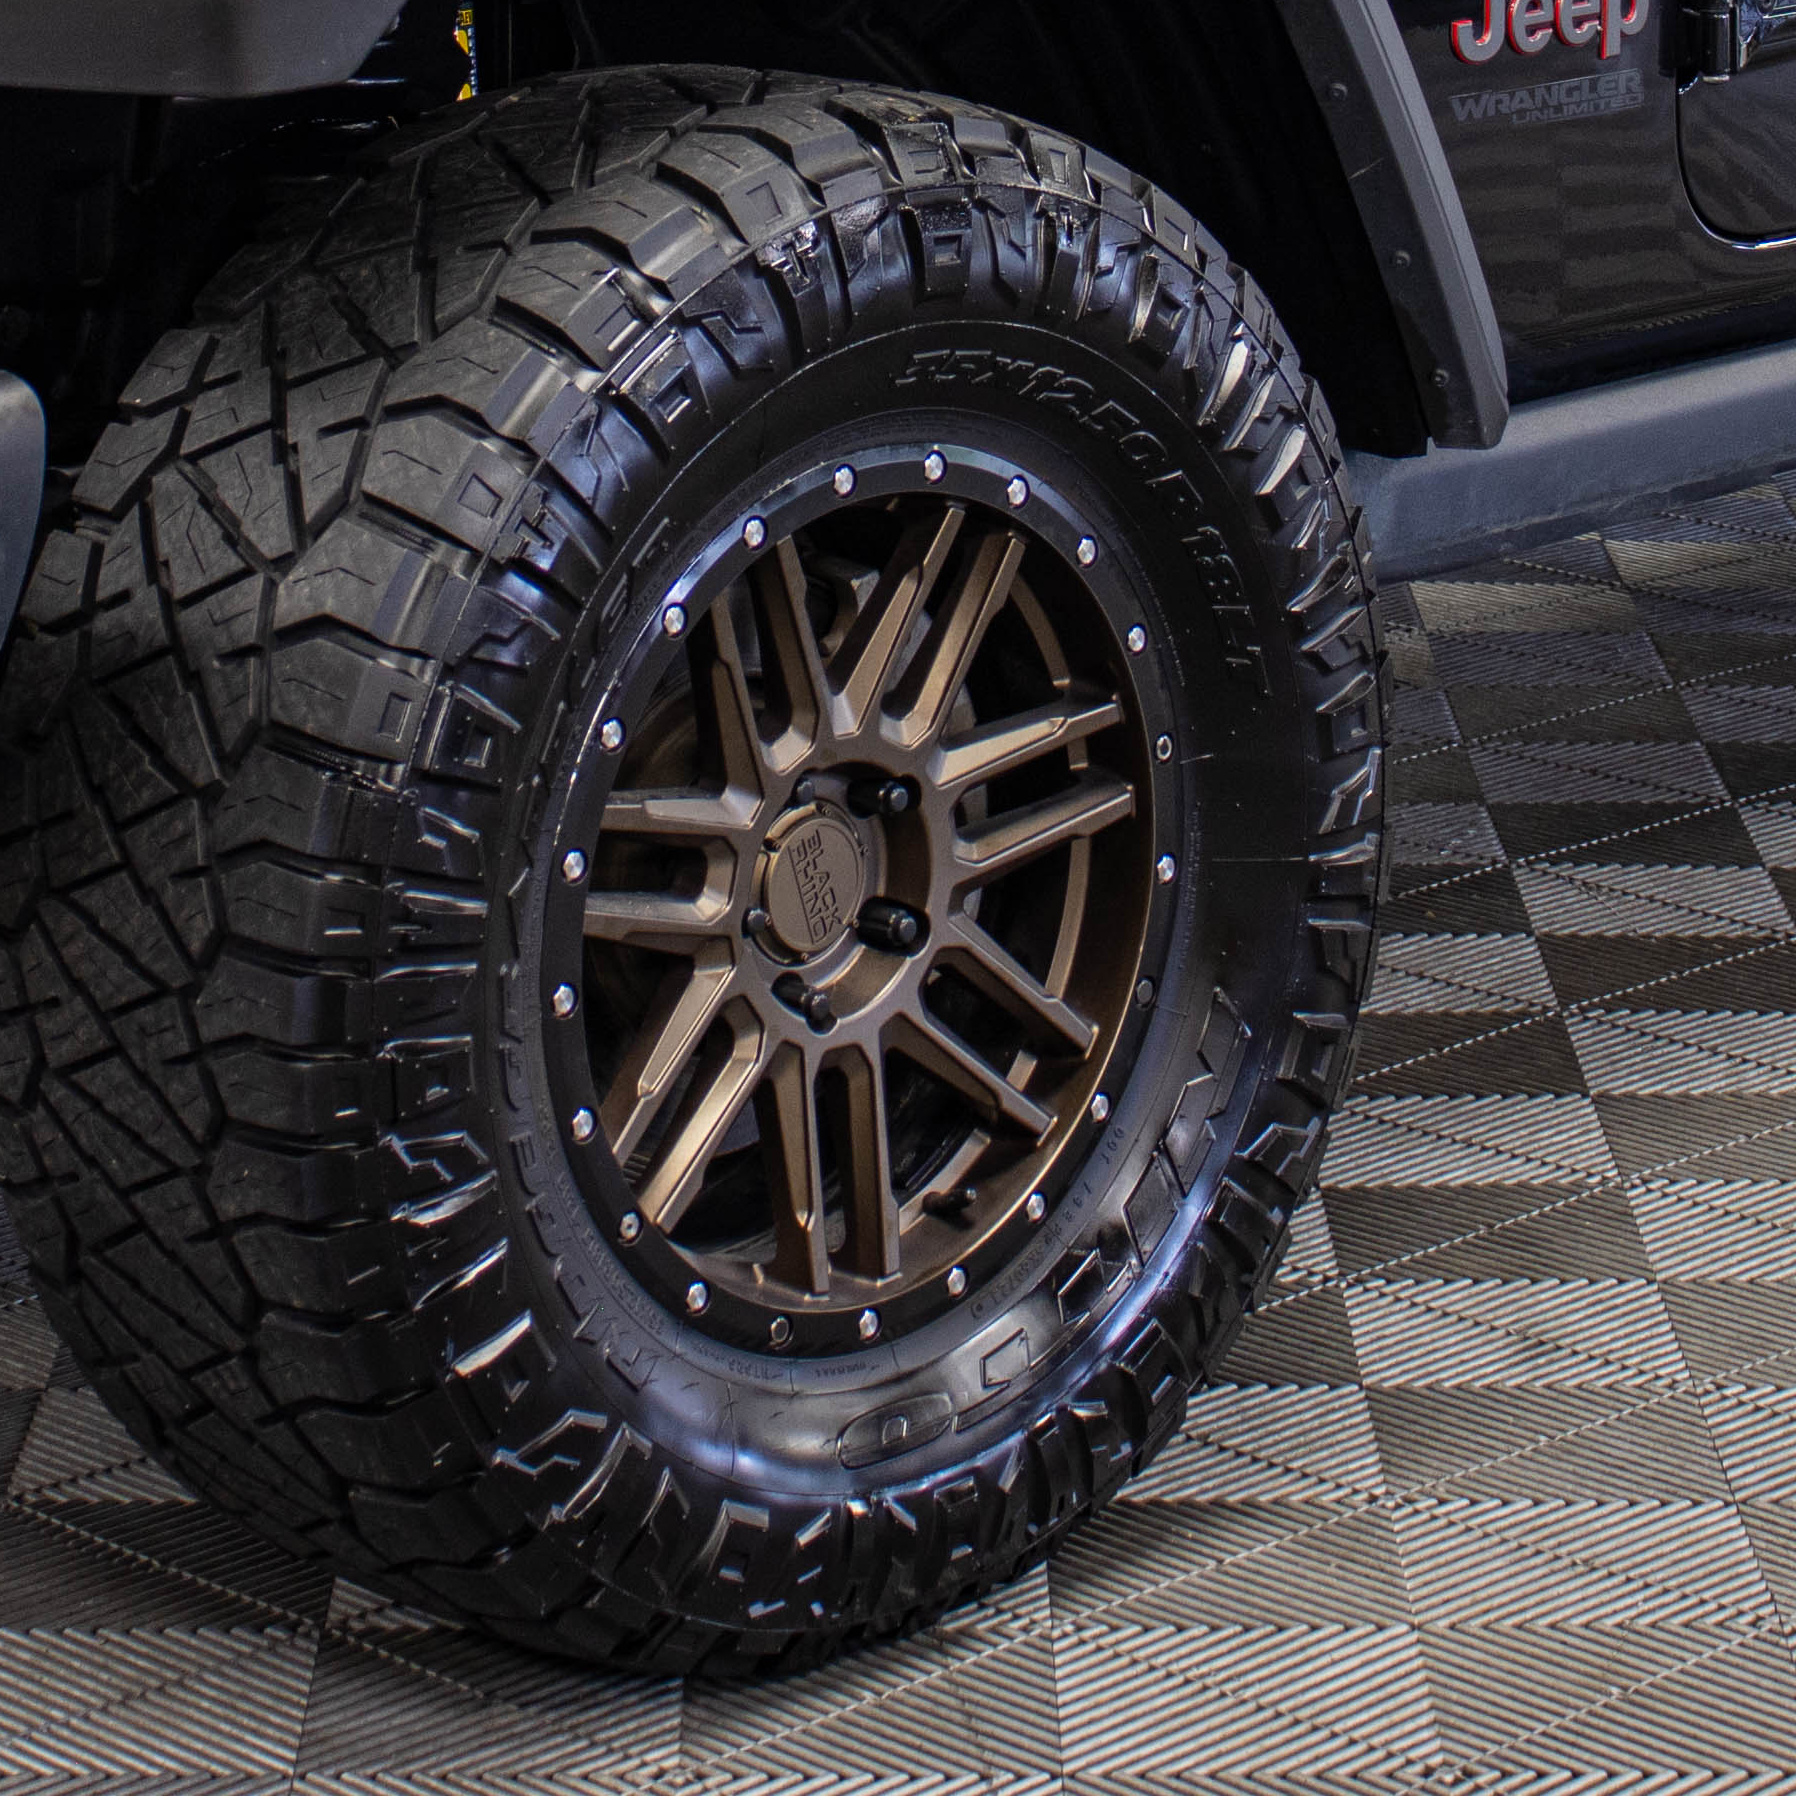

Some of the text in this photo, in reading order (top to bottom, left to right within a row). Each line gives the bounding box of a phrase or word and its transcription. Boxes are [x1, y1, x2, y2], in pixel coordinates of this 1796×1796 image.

[1452, 69, 1644, 122] WRANGLER
[1511, 91, 1645, 125] UNLIMITED
[791, 837, 828, 944] RHINO
[806, 828, 843, 933] BLACK
[836, 984, 1252, 1470] NITTO
